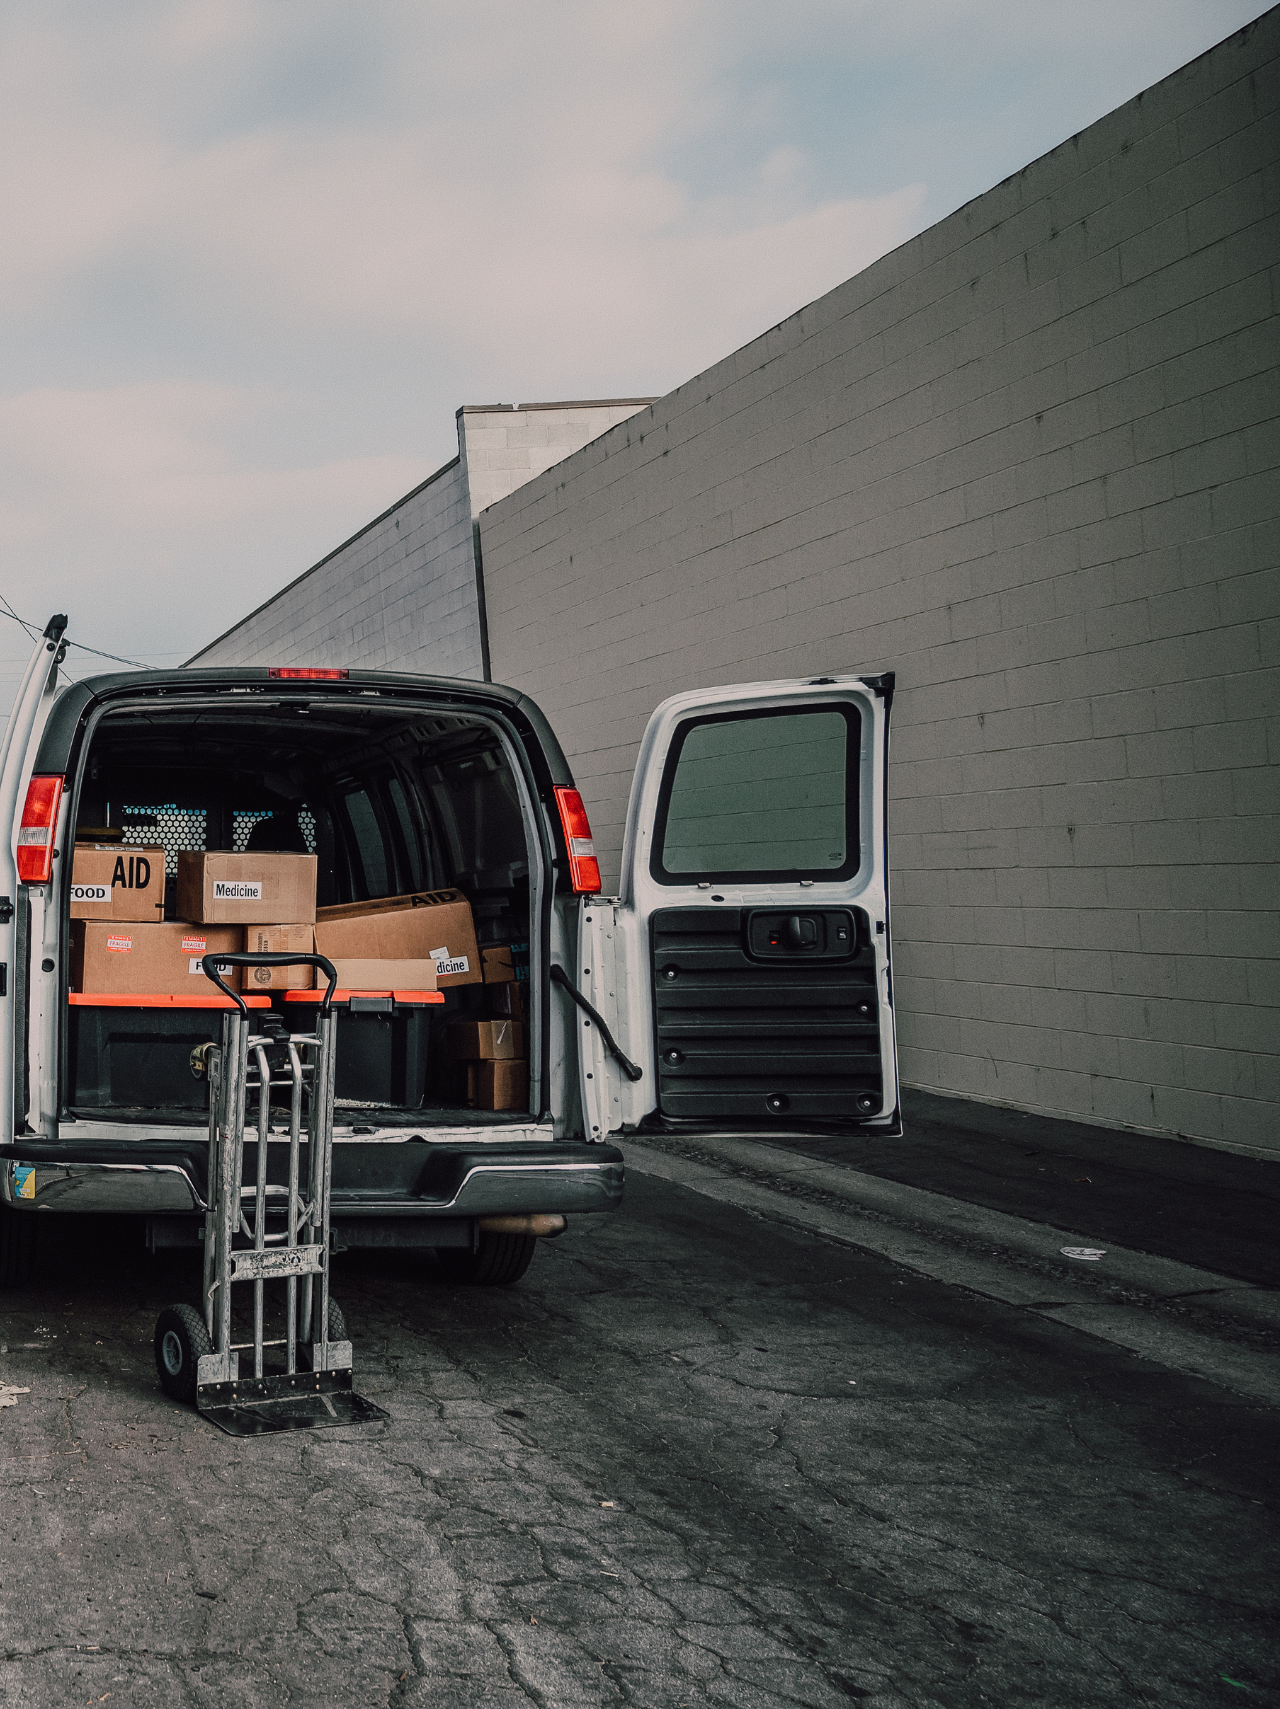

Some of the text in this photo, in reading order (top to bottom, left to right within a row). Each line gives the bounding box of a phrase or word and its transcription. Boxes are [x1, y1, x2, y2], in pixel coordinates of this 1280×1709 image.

[111, 855, 151, 889] AID
[215, 883, 259, 898] Medicine
[411, 891, 457, 907] AID
[109, 940, 130, 948] FRAGILE
[196, 961, 227, 972] FD
